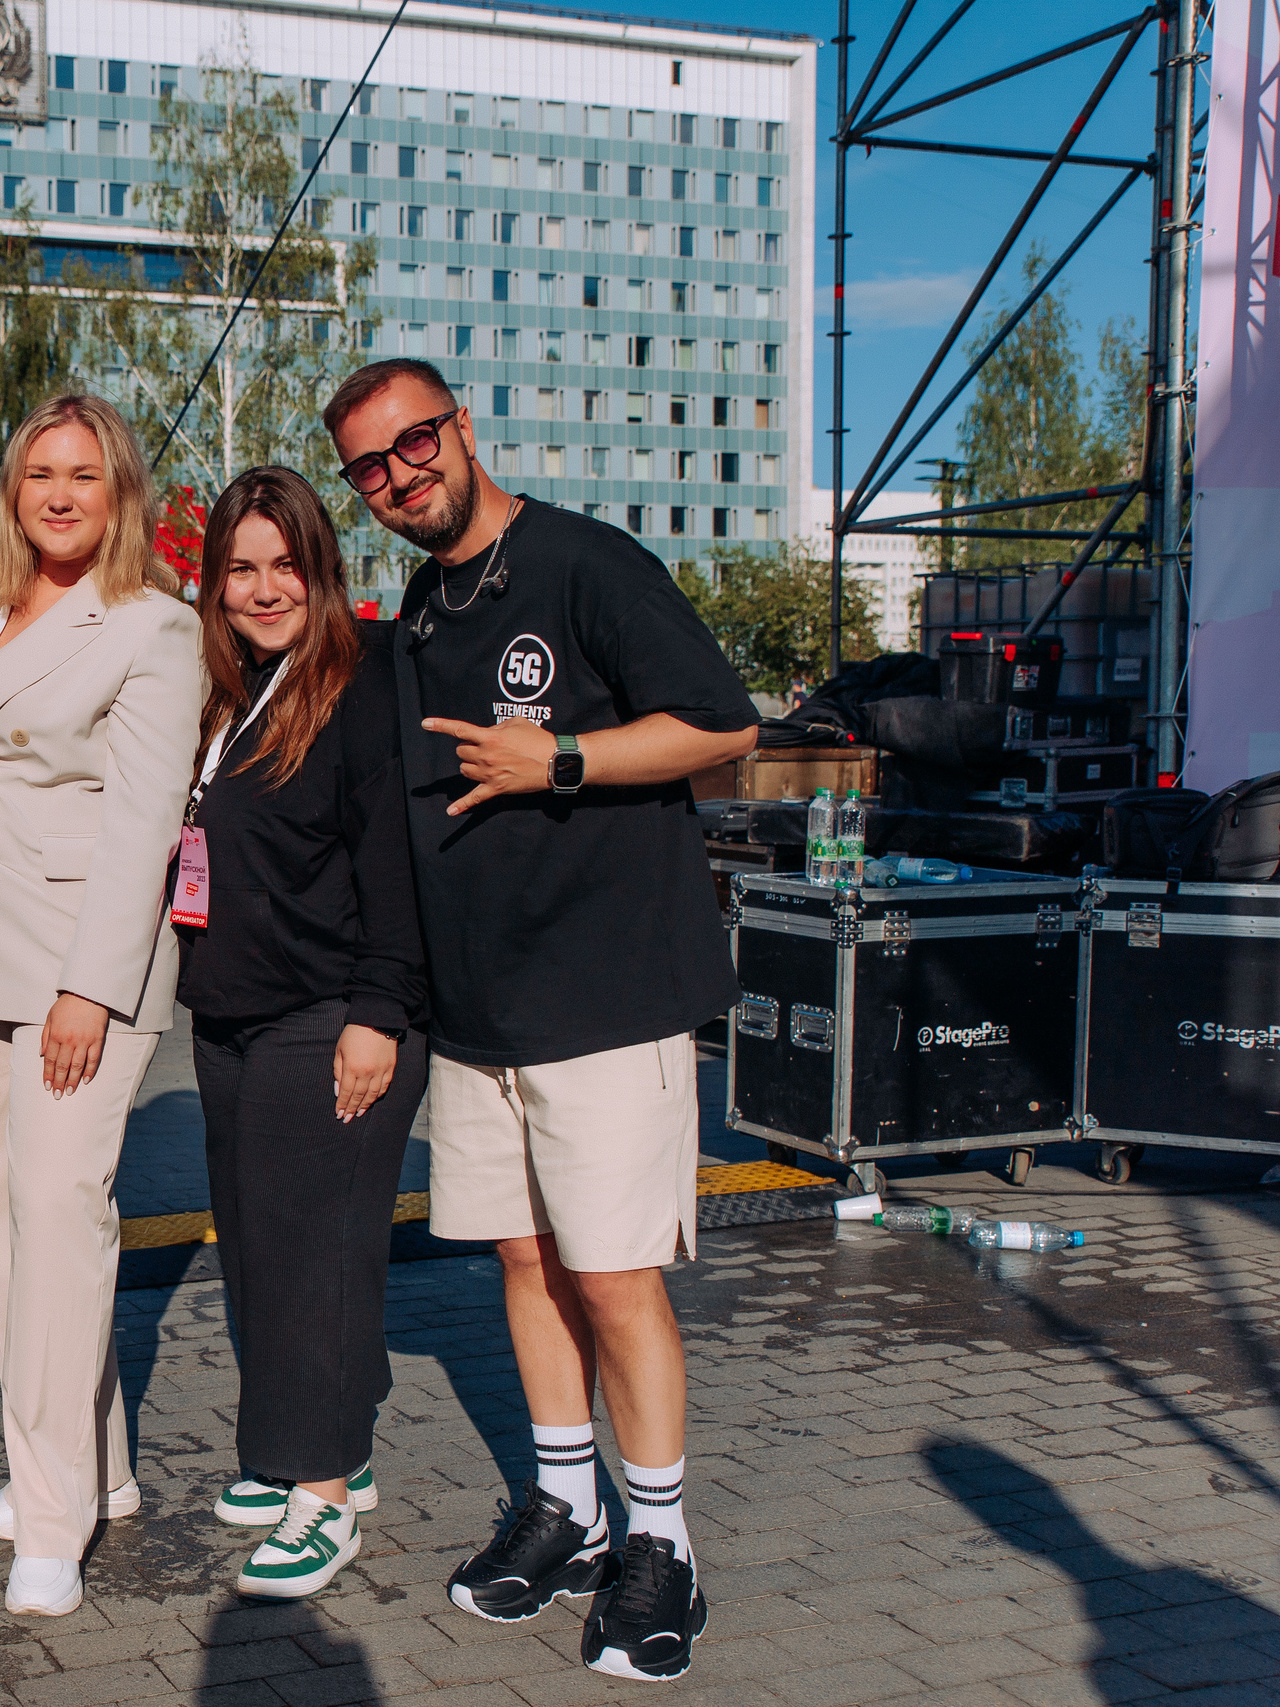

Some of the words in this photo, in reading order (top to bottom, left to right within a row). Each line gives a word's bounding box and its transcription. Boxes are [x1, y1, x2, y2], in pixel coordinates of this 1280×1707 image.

[506, 651, 542, 686] 5G
[493, 702, 552, 720] VETEMENTS
[935, 1021, 1010, 1048] StagePro
